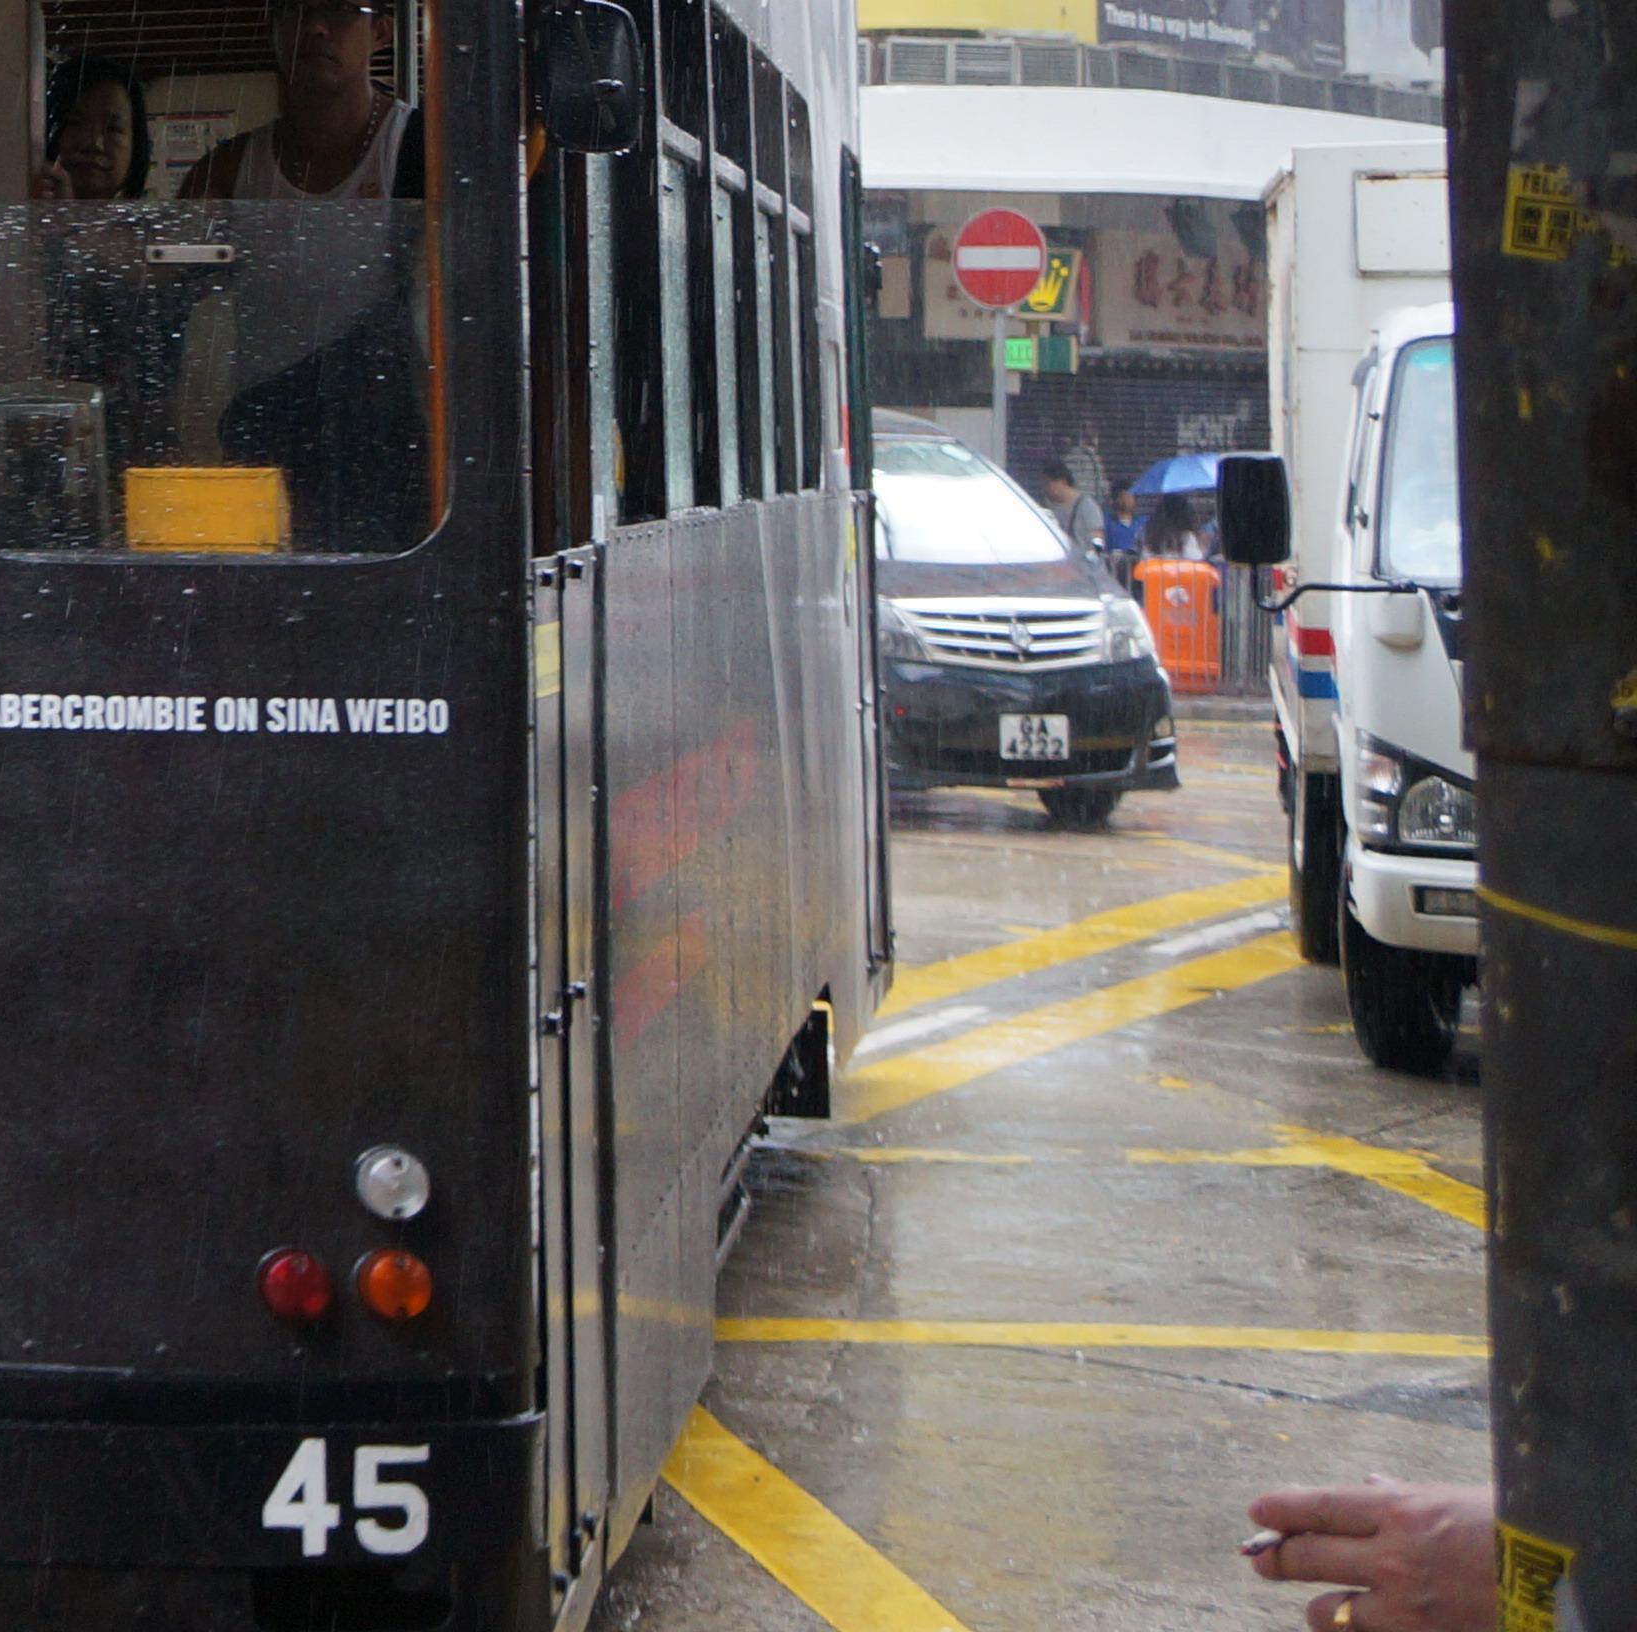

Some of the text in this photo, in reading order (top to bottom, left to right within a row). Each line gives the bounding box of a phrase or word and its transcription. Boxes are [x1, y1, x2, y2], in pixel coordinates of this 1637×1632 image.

[214, 696, 259, 733] ON
[265, 697, 339, 734] SINA
[343, 698, 449, 736] WEIBO
[262, 1435, 431, 1558] 45
